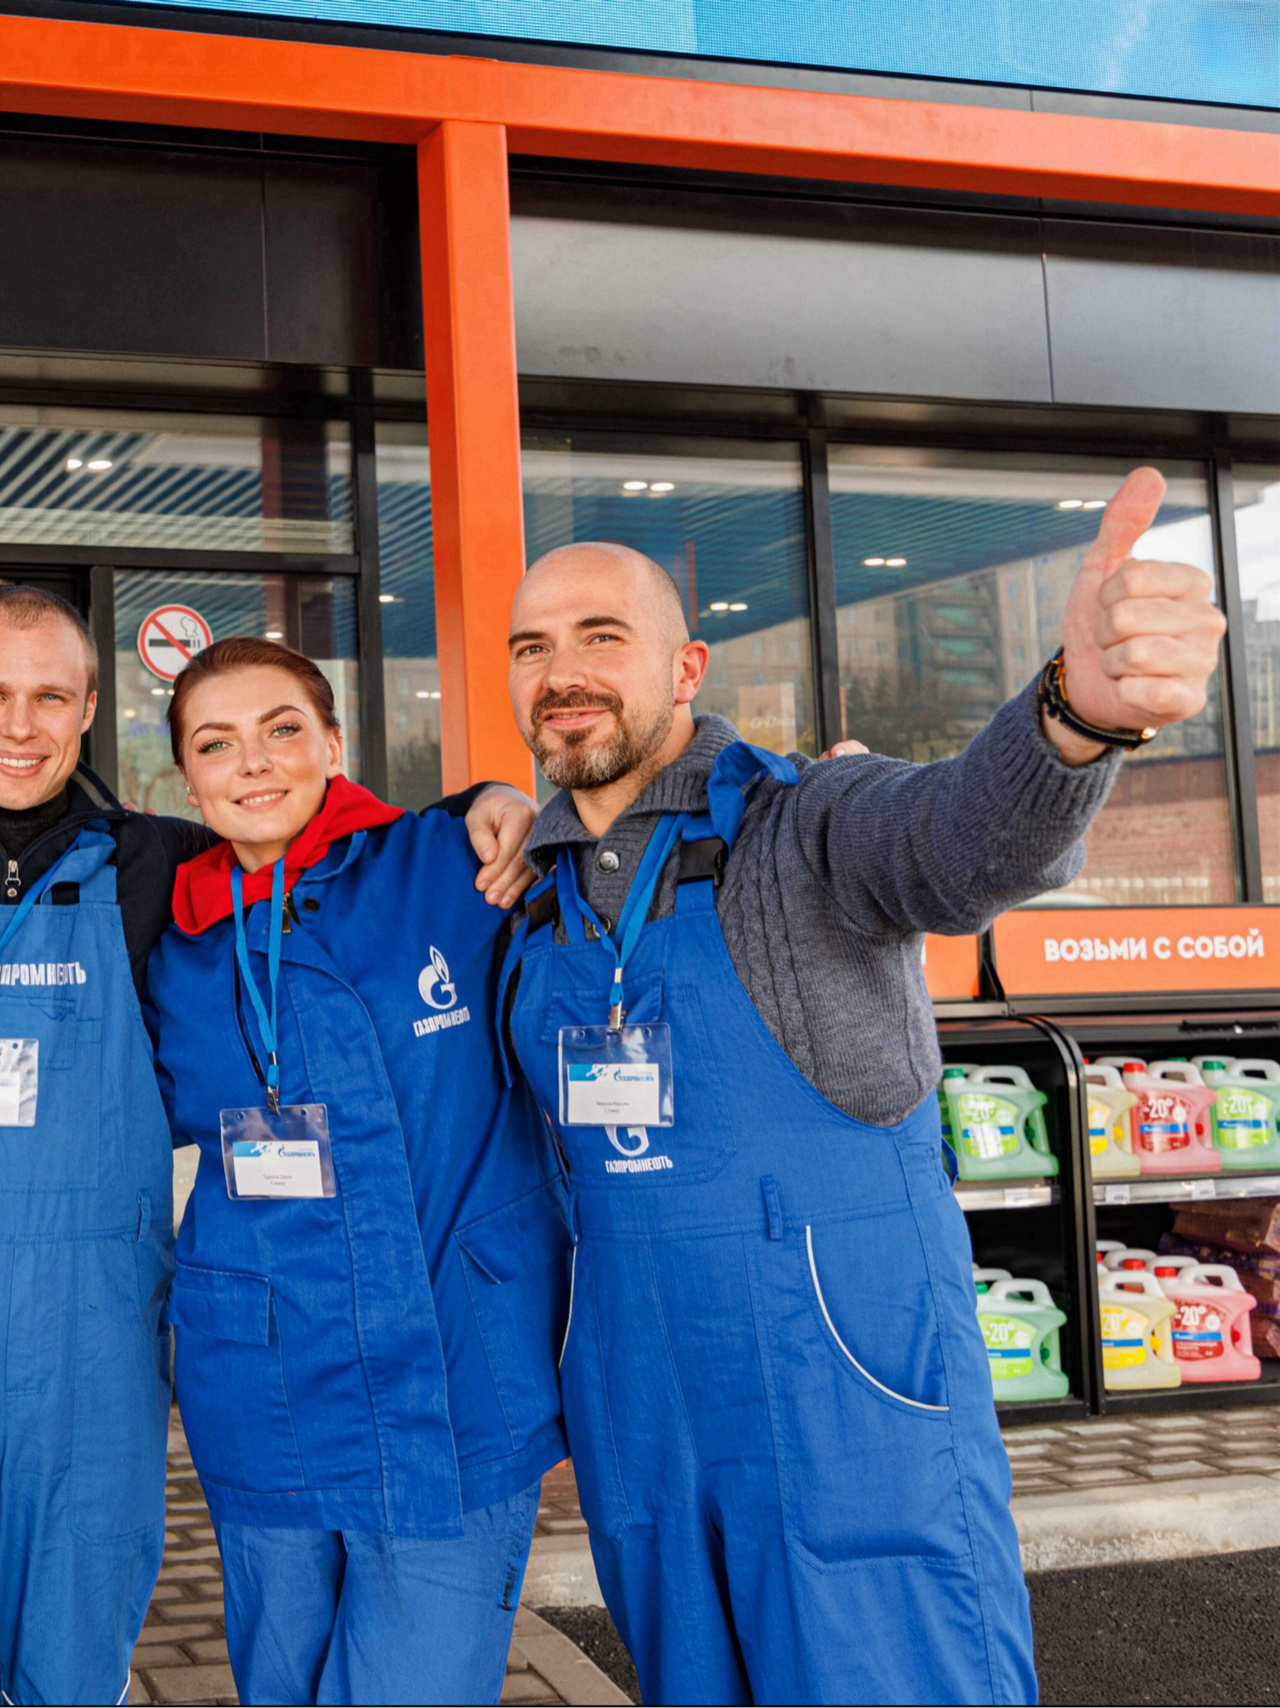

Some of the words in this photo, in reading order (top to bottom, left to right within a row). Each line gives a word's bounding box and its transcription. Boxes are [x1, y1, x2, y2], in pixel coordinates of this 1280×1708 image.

[1044, 936, 1148, 961] ВОЗЬМИ
[1153, 937, 1172, 959] С
[1177, 928, 1265, 959] СОБОЙ
[605, 1155, 673, 1174] ГАЗПРОМНЕФТЬ
